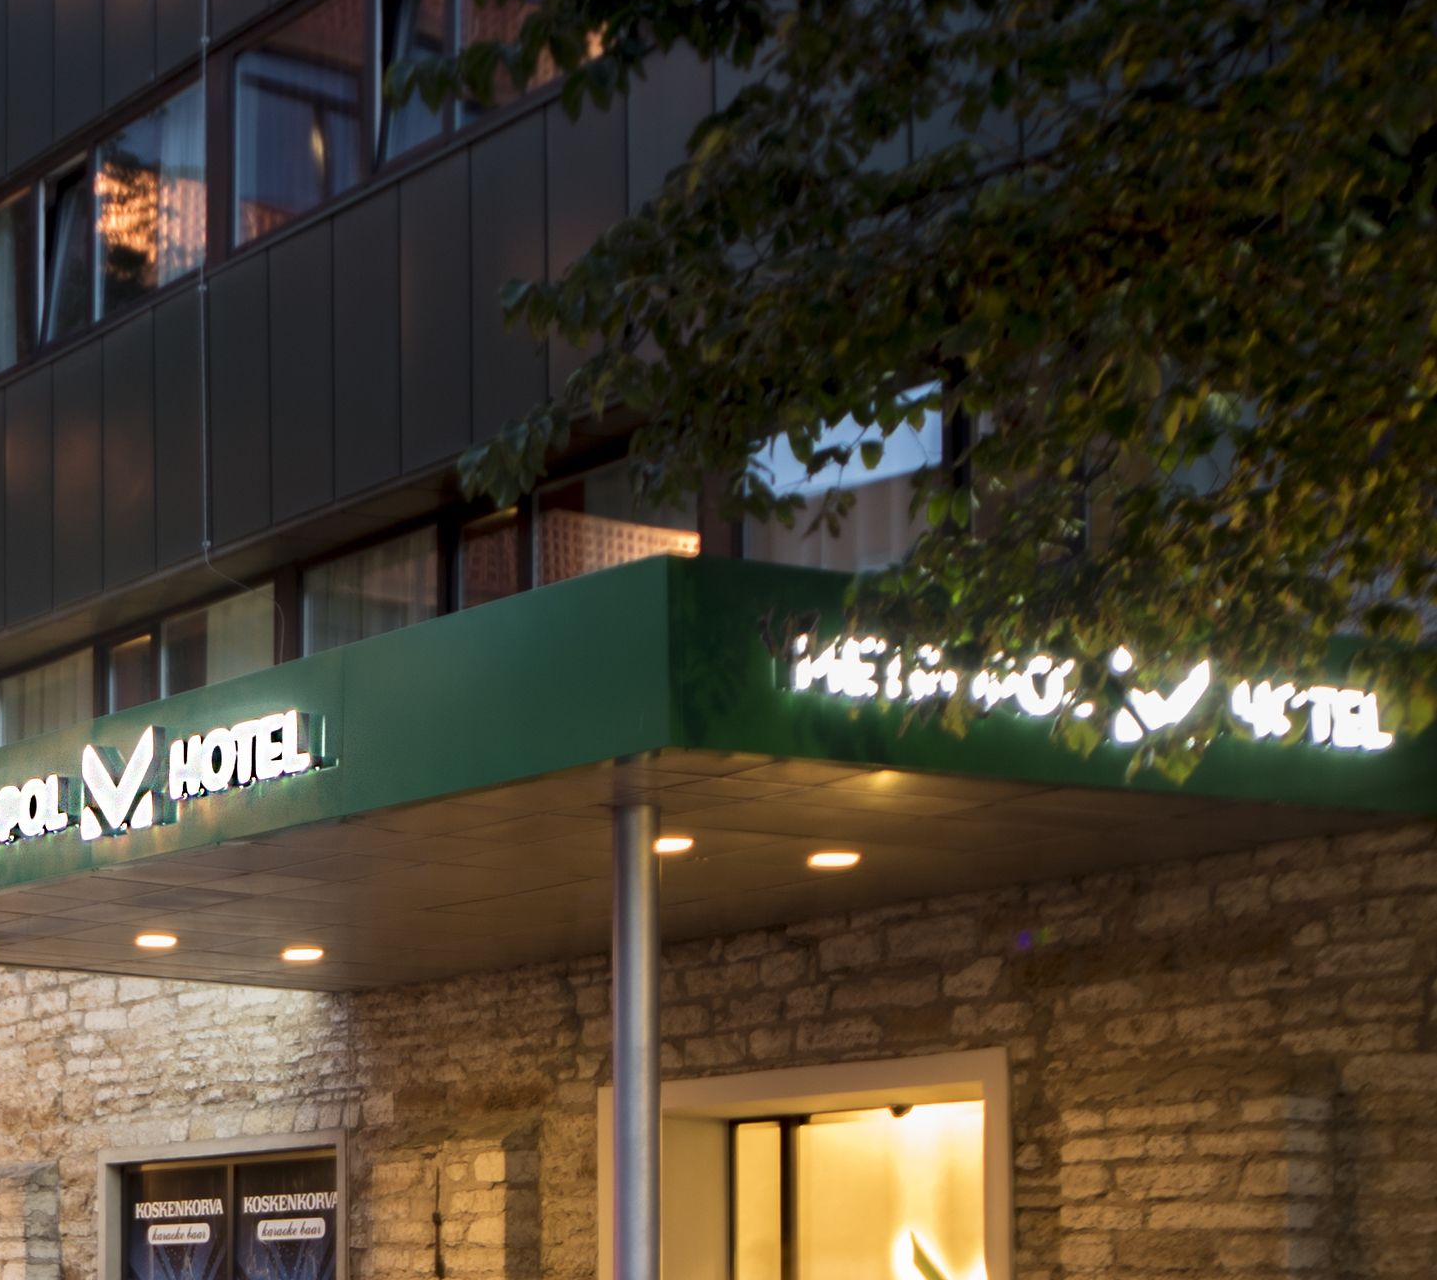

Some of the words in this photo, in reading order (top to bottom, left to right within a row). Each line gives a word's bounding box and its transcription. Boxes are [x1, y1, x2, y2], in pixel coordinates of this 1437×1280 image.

[169, 709, 312, 801] HOTEL
[135, 1198, 224, 1219] KOSKENKORVA
[244, 1191, 339, 1214] KOSKENKORVA
[151, 1226, 185, 1241] karaoke
[186, 1226, 207, 1240] baar
[261, 1222, 298, 1238] karaoke
[300, 1220, 322, 1236] baar
